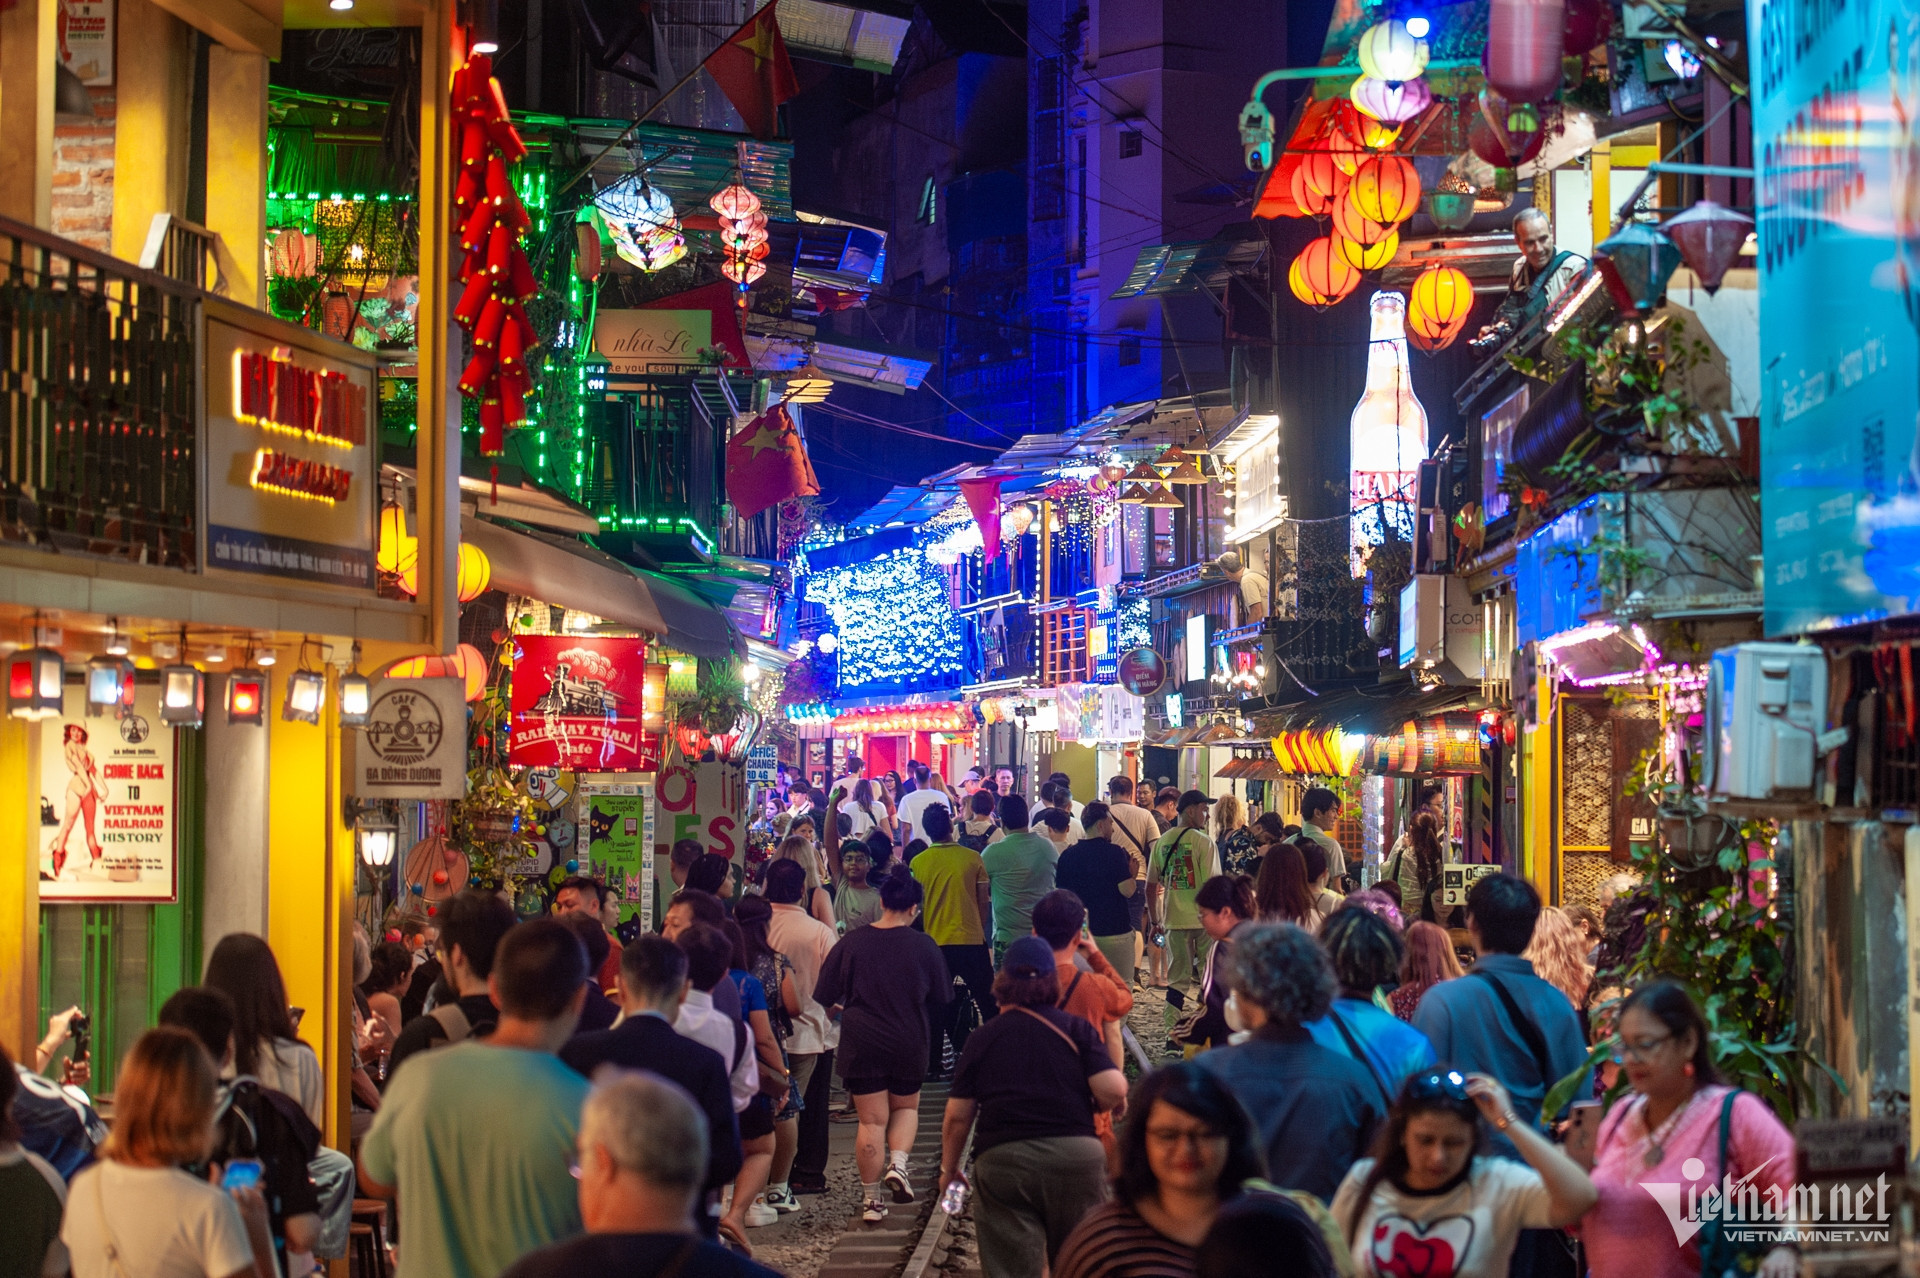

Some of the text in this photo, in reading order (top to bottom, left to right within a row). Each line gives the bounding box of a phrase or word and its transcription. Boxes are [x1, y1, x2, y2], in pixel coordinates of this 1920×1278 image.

[624, 364, 650, 374] you
[391, 694, 417, 706] CAFÉ
[559, 743, 593, 756] Café
[749, 747, 776, 758] OFFICE
[103, 763, 164, 780] COME BACK
[365, 767, 379, 781] GA
[758, 770, 769, 779] 4G
[128, 785, 140, 800] TO
[104, 805, 164, 816] VIETNAM
[104, 818, 164, 829] RAILROAD
[1631, 817, 1649, 835] GA
[103, 833, 163, 843] HISTORY
[515, 858, 539, 866] TUPID
[515, 865, 539, 873] EOPLE
